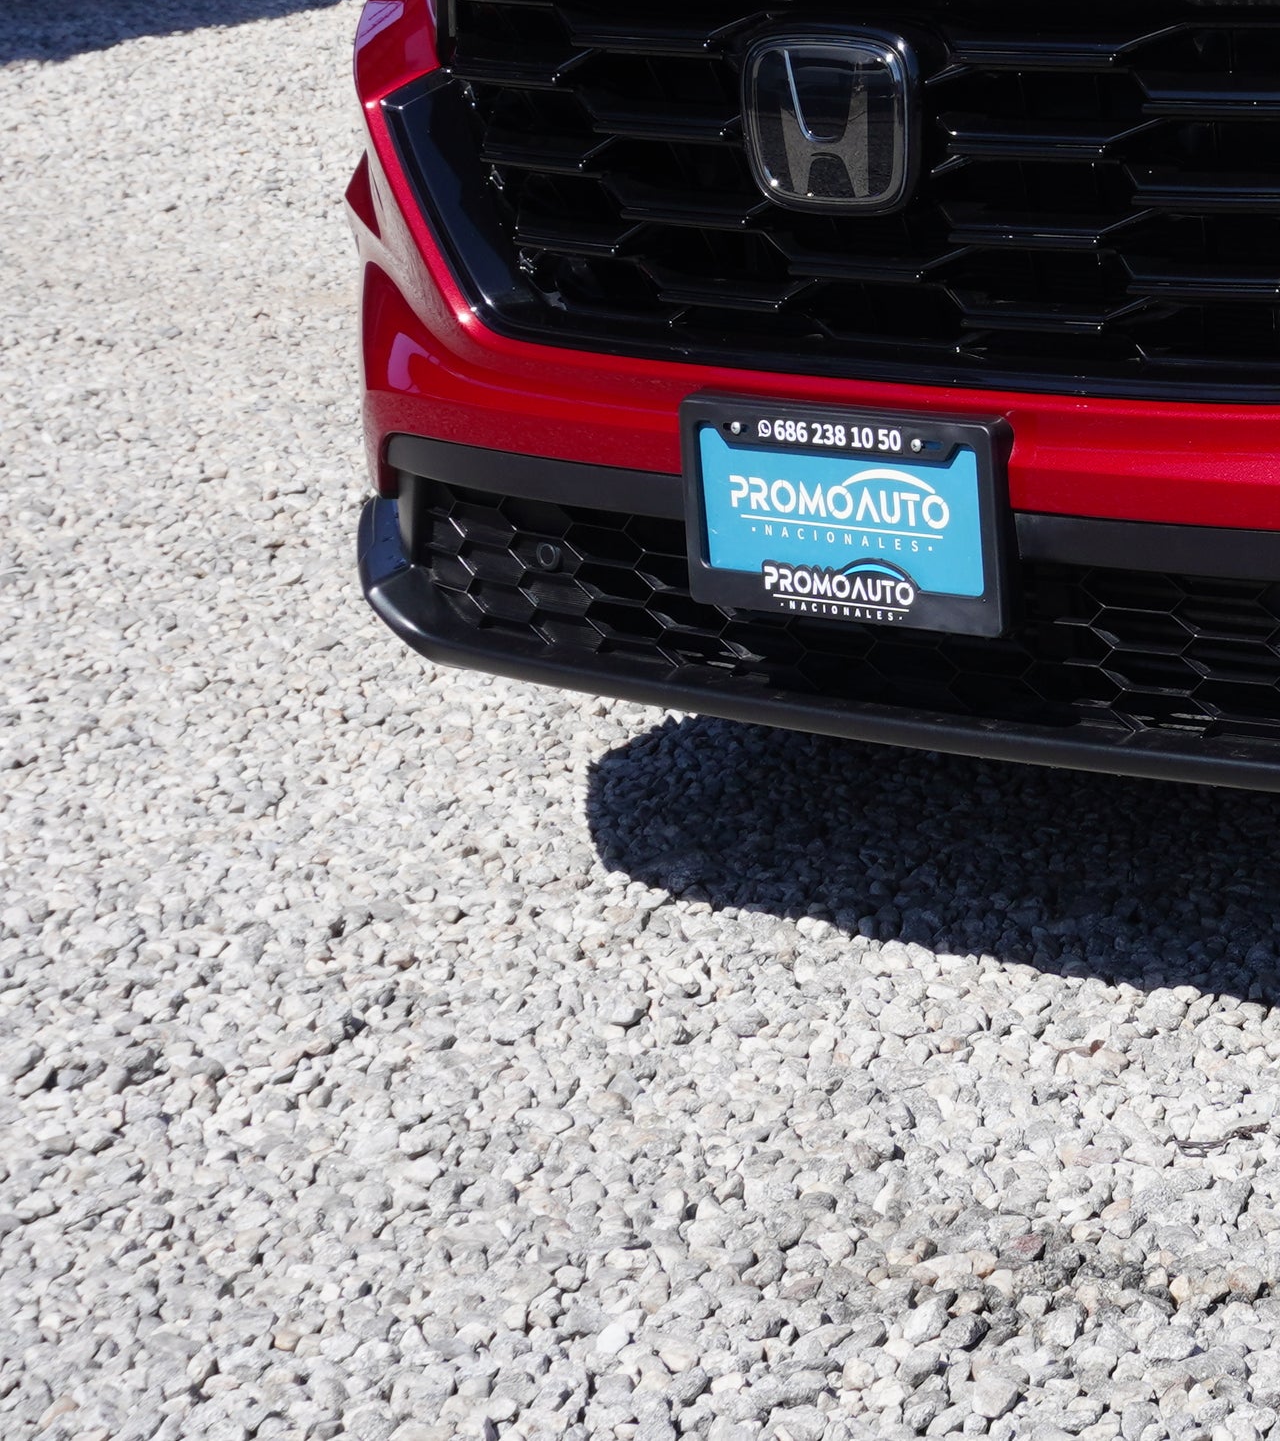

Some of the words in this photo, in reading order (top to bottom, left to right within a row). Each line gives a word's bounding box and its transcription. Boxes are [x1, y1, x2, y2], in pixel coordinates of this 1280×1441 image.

[774, 419, 808, 443] 686
[812, 423, 846, 447] 238
[851, 427, 874, 449] 10
[877, 429, 901, 451] 50
[729, 474, 950, 530] PROMOAUTO
[765, 524, 919, 552] NACIONALES
[763, 565, 914, 606] PROMOAUTO
[789, 600, 894, 621] NACIONALES
